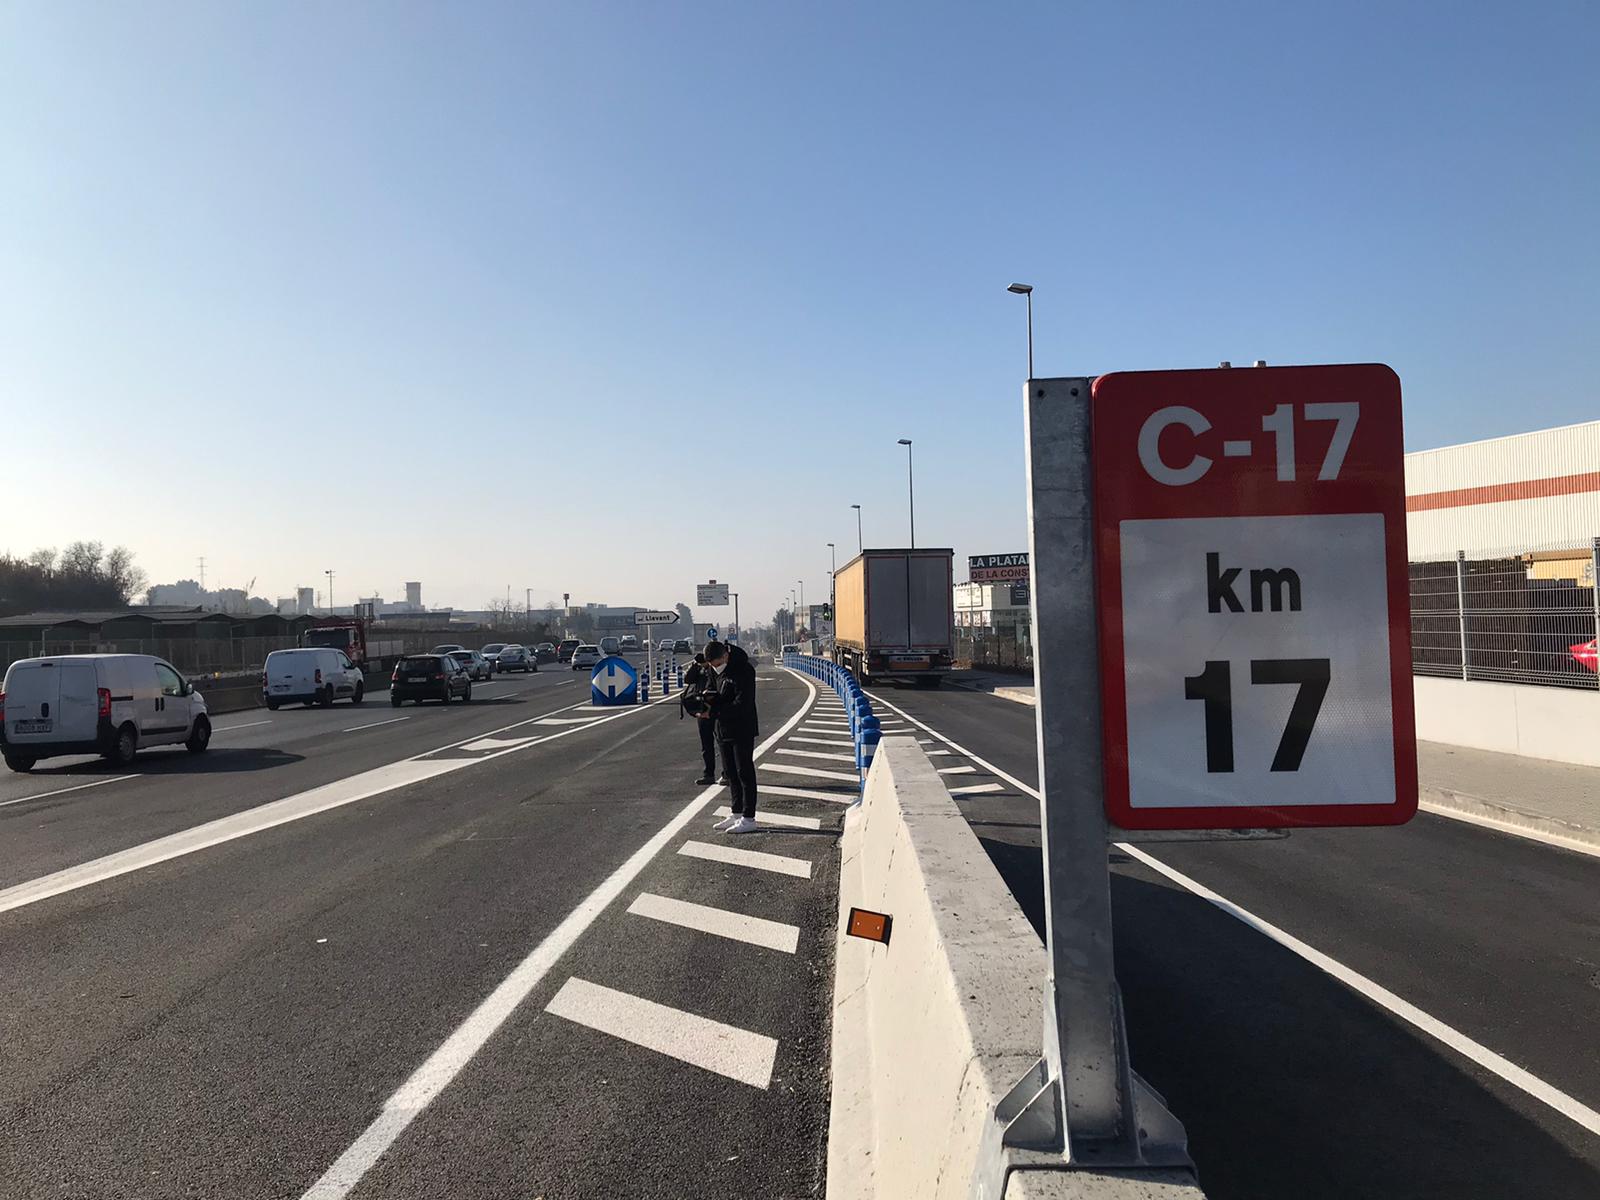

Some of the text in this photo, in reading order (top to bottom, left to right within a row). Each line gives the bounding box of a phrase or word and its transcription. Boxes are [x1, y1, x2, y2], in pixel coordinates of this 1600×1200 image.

[1138, 402, 1360, 486] C-17
[970, 555, 1029, 567] LA PLATA
[971, 568, 1030, 579] DE LA CONS
[1206, 552, 1302, 613] km
[1185, 659, 1330, 773] 17
